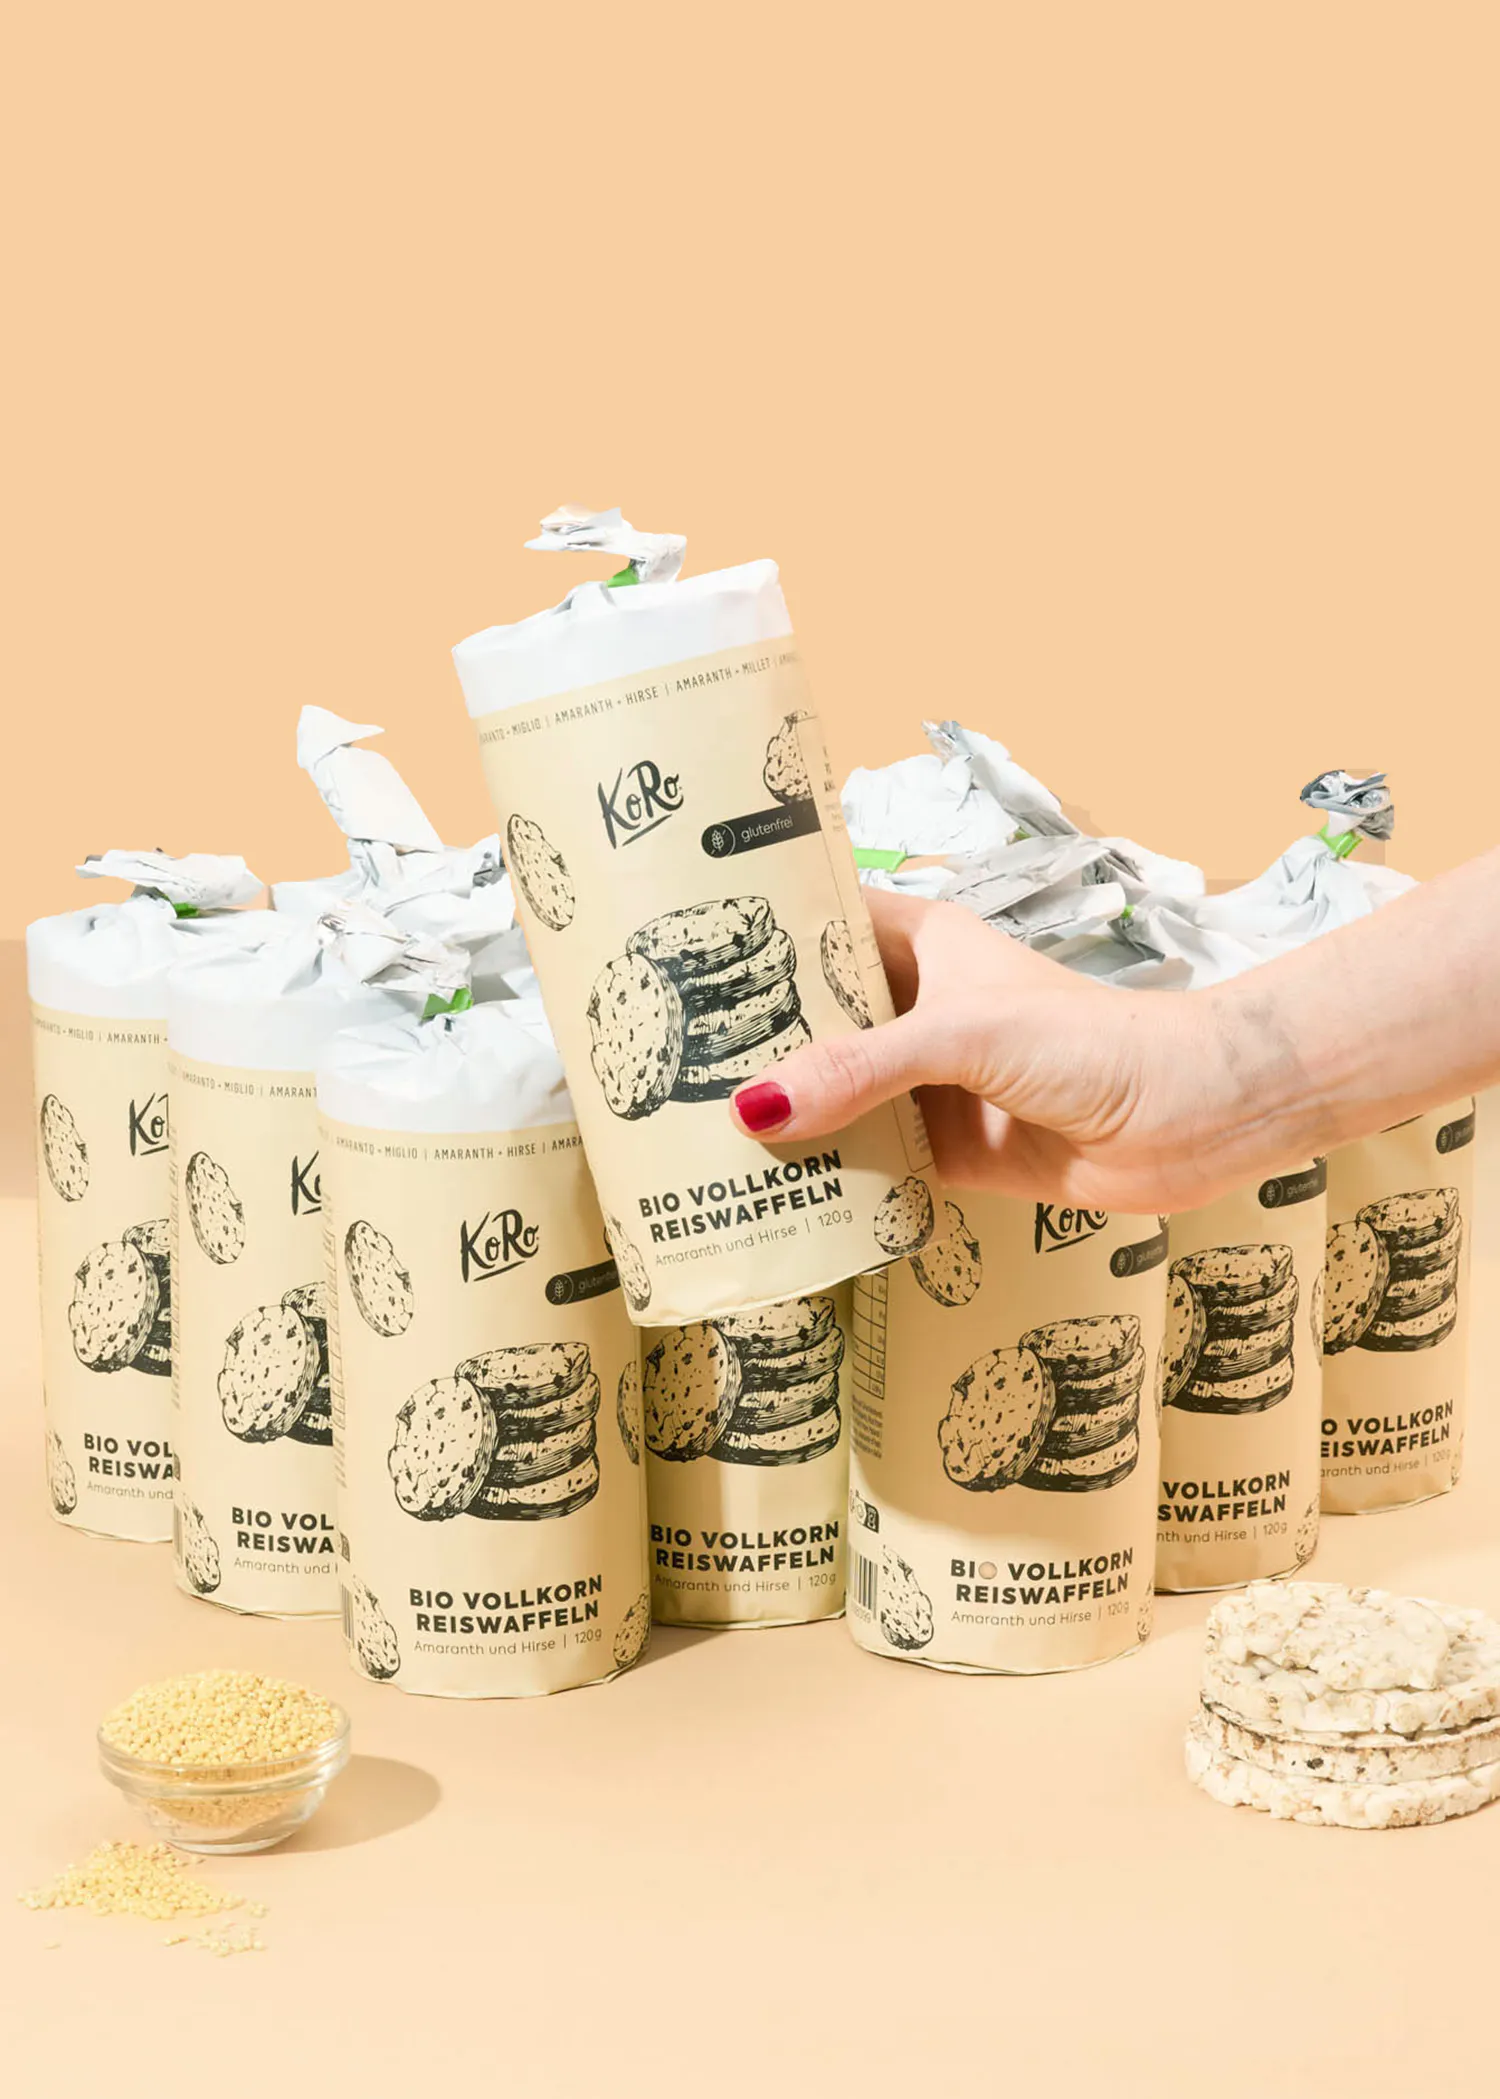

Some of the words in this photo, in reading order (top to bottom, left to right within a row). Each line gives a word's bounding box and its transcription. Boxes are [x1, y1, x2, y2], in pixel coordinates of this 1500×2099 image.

[511, 717, 541, 735] MIGLIO
[554, 698, 614, 724] AMARANTH
[625, 686, 659, 705] HIRSE
[676, 666, 733, 692] AMARANTH
[742, 657, 770, 674] MILLET
[597, 759, 684, 849] KoRo
[741, 815, 794, 843] glutenfrei
[68, 1027, 94, 1041] MIGLIO
[107, 1032, 160, 1045] AMARANTH
[224, 1081, 255, 1096] MIGLIO
[269, 1086, 317, 1098] AMARANT
[385, 1145, 418, 1159] MIGLIO
[434, 1148, 494, 1160] AMARANTH
[507, 1142, 536, 1157] HIRSE
[552, 1135, 584, 1151] AMARA
[638, 1192, 681, 1218] BIO
[687, 1149, 842, 1206] VOLLKORN
[650, 1177, 843, 1243] REISWAFFELN
[460, 1209, 539, 1283] KoRo
[655, 1243, 722, 1267] Amaranth
[725, 1233, 755, 1251] und
[759, 1223, 798, 1243] Hirse
[1347, 1399, 1453, 1435] VOLLKORN
[84, 1432, 118, 1454] BIO
[1320, 1422, 1450, 1458] EISWAFFELN
[89, 1456, 173, 1480] REISWA
[1320, 1464, 1362, 1478] aranth
[1365, 1463, 1390, 1476] und
[1394, 1458, 1420, 1472] Hirse
[87, 1482, 145, 1499] Amaranth
[148, 1489, 173, 1500] und
[1162, 1469, 1290, 1500] VOLLKORN
[232, 1507, 272, 1528] BIO
[1157, 1494, 1286, 1523] SWAFFELN
[237, 1531, 335, 1554] REISWA
[651, 1523, 692, 1546] BIO
[701, 1521, 839, 1549] VOLLKORN
[1184, 1530, 1210, 1544] und
[1214, 1528, 1247, 1542] Hirse
[234, 1557, 300, 1574] Amaranth
[304, 1562, 330, 1574] und
[655, 1545, 835, 1572] REISWAFFELN
[1007, 1547, 1133, 1582] VOLLKORN
[409, 1588, 454, 1610] BIO
[462, 1574, 603, 1611] VOLLKORN
[654, 1573, 720, 1592] Amaranth
[724, 1579, 751, 1592] und
[755, 1580, 790, 1592] Hirse
[956, 1573, 1128, 1605] REISWAFFELN
[416, 1599, 600, 1634] REISWAFFELN
[951, 1610, 1025, 1627] Amaranth
[1029, 1612, 1056, 1626] und
[1060, 1610, 1092, 1624] Hirse
[414, 1640, 484, 1655] Amaranth
[488, 1640, 516, 1655] und
[521, 1638, 556, 1652] Hirse
